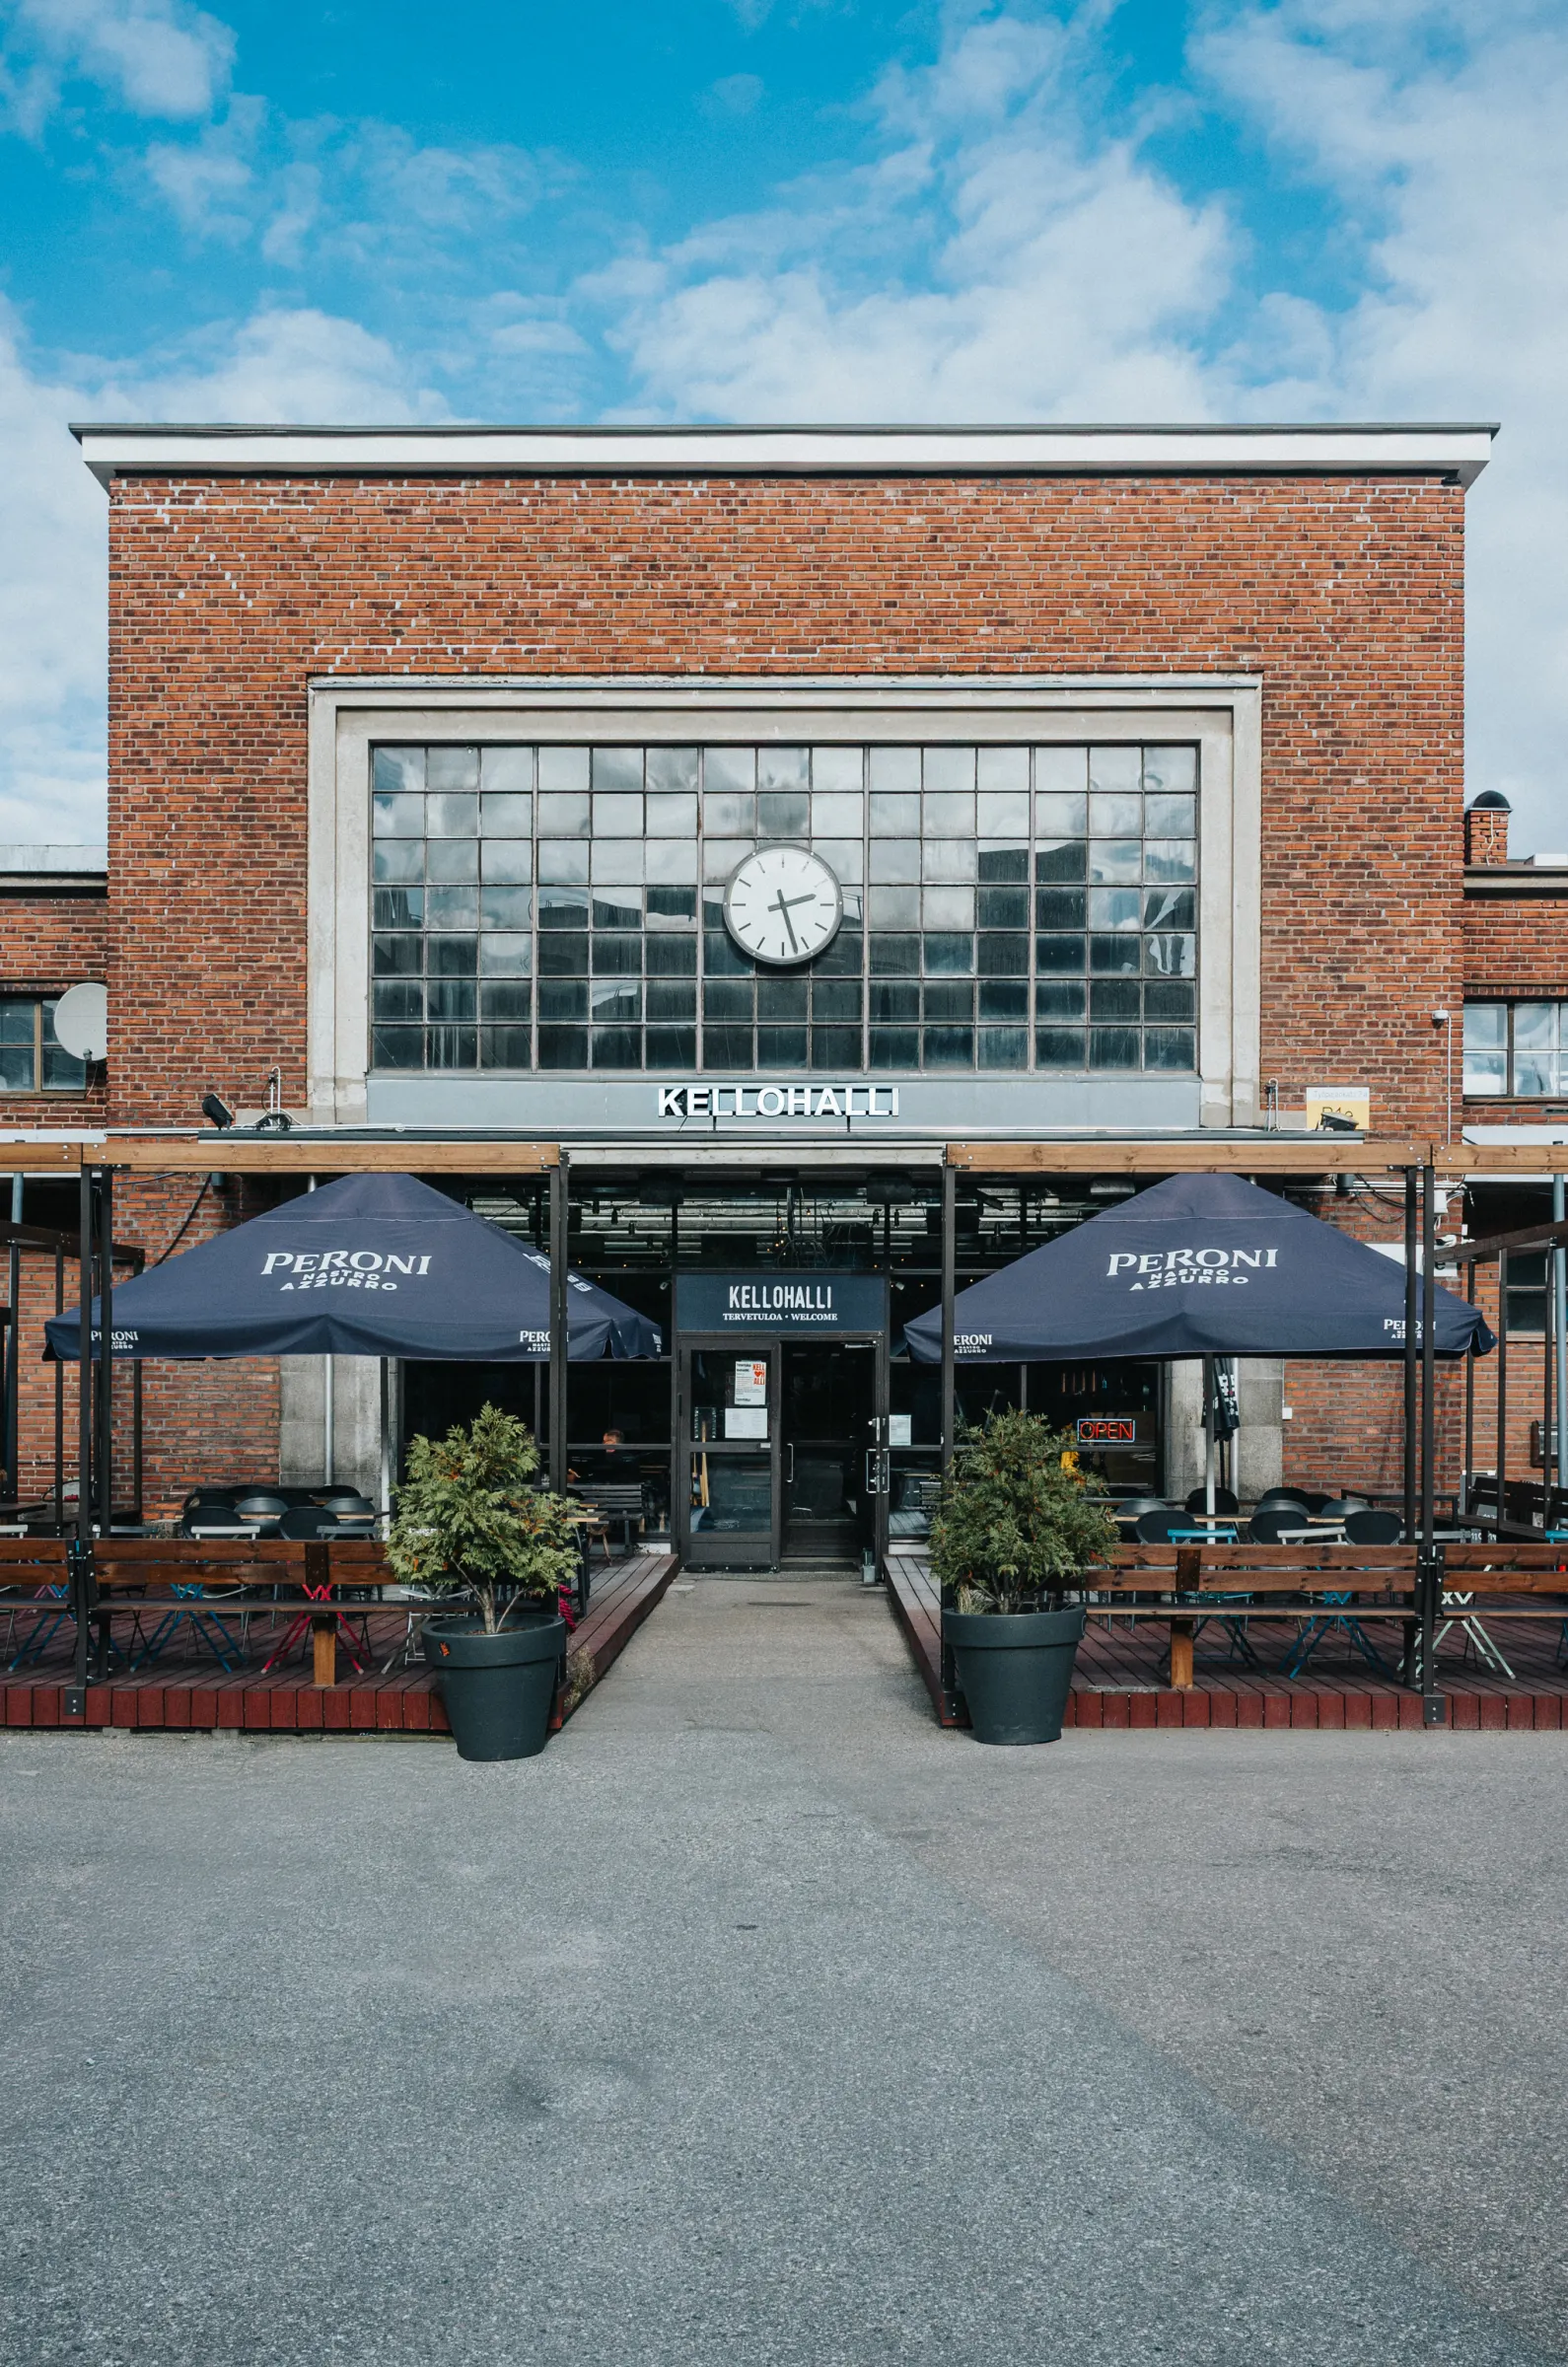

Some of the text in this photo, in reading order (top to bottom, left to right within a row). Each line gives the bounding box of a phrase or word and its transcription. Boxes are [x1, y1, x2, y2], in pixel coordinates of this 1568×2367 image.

[658, 1087, 899, 1116] KELLOHALLI
[260, 1251, 432, 1275] PERONI
[1106, 1249, 1278, 1276] PERONI
[303, 1269, 380, 1281] NASTRO
[1151, 1268, 1229, 1281] NASTRO
[280, 1276, 397, 1291] AZZURRO
[1129, 1276, 1248, 1291] AZZURRO
[730, 1286, 831, 1309] KELLOHALLI
[954, 1334, 992, 1345] ERONI
[1080, 1421, 1133, 1440] OPEN
